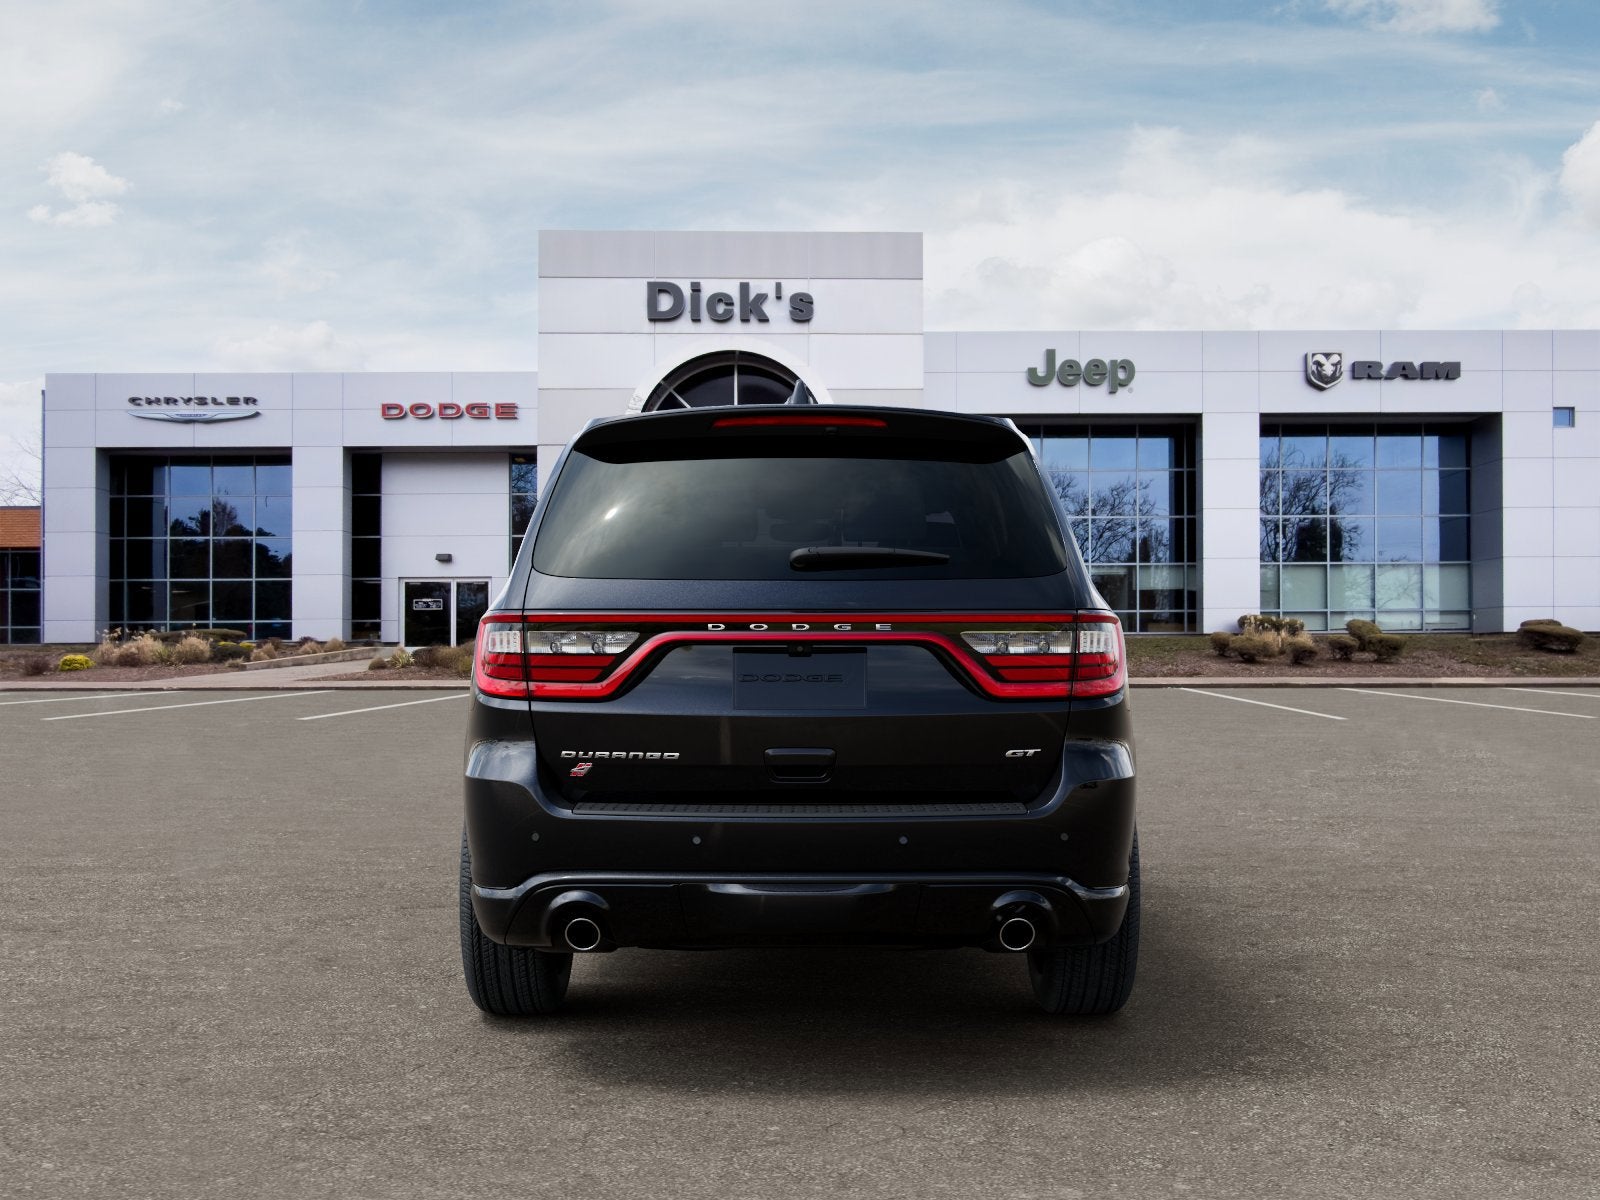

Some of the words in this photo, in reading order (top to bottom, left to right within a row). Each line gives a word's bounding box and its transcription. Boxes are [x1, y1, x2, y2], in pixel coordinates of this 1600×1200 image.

[646, 280, 815, 322] Dick's
[1026, 348, 1136, 394] Jeep
[1351, 360, 1461, 380] RAM
[127, 396, 259, 407] CHRYSLER
[381, 402, 519, 420] DODGE
[707, 623, 893, 631] DODGE
[738, 673, 844, 683] DODGE
[560, 750, 680, 760] DURANGO
[1005, 748, 1042, 758] GT
